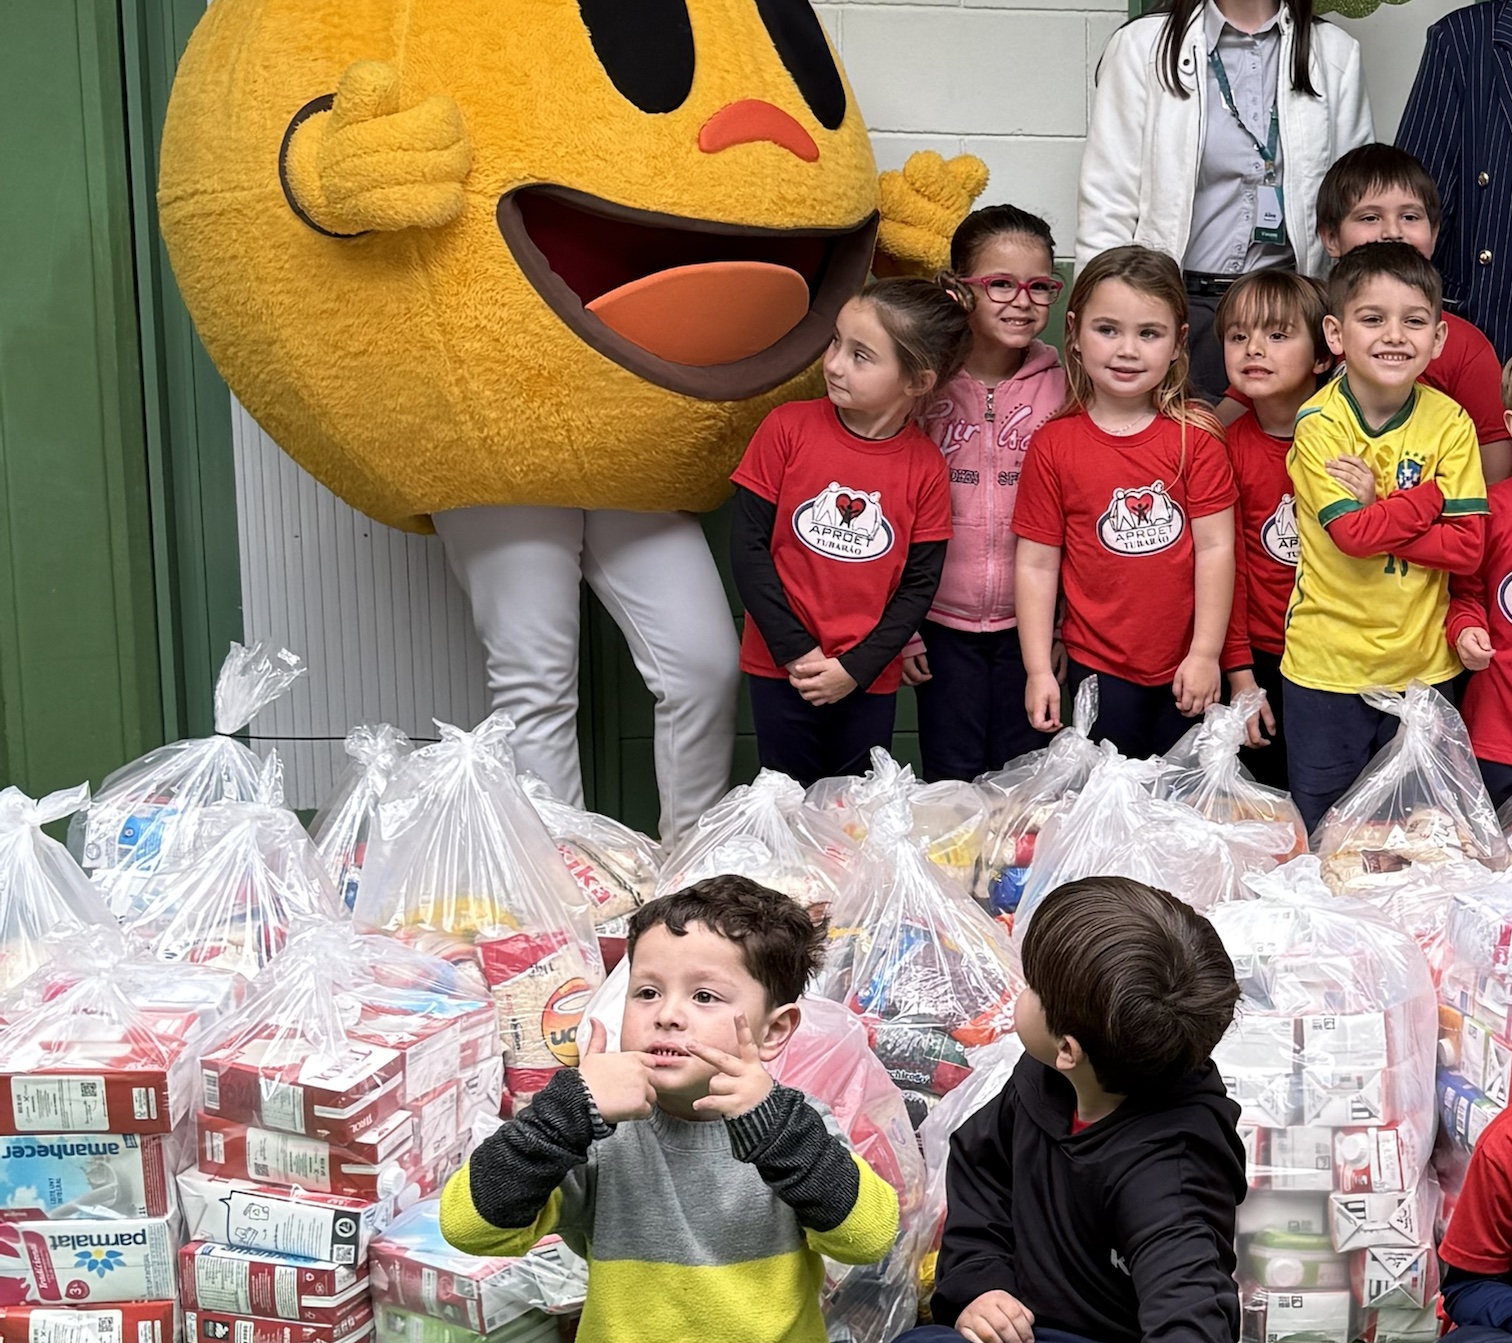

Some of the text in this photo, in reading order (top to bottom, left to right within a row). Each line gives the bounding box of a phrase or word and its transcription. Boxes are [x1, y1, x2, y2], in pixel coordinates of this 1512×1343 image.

[808, 525, 875, 548] APROET
[1115, 525, 1174, 543] APROET
[1123, 535, 1170, 551] TUBARÃO
[816, 538, 862, 556] TUBARÃO
[0, 1142, 120, 1159] amanhecer
[49, 1228, 148, 1251] parmalat
